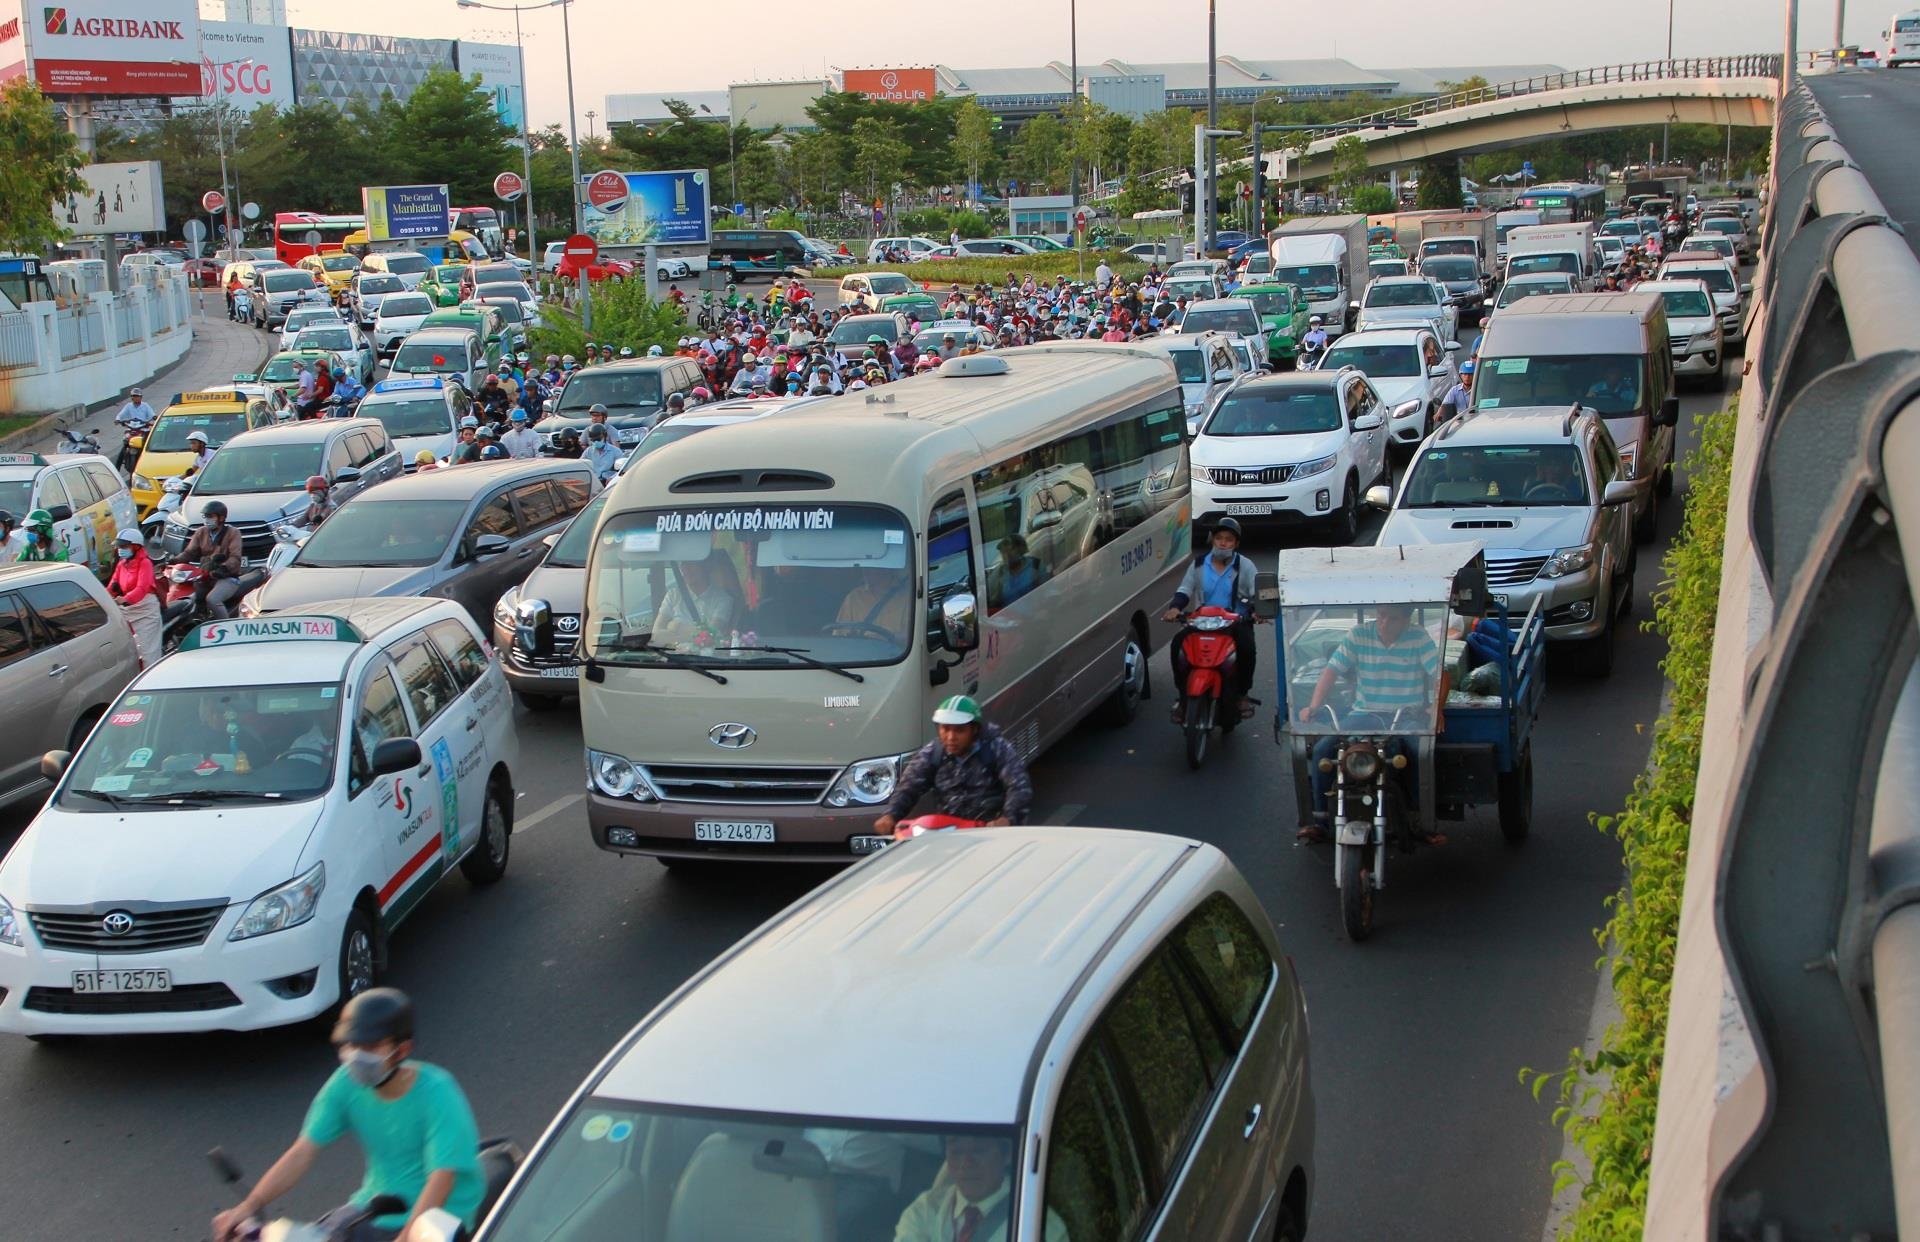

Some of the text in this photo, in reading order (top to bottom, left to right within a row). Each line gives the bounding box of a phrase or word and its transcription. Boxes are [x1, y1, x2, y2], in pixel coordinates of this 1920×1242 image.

[72, 17, 184, 40] AGRIBANK
[226, 34, 234, 42] to
[236, 33, 264, 44] Vietnam
[222, 63, 271, 94] SCG
[863, 90, 926, 100] anwha Life
[400, 193, 433, 202] The Grand
[392, 203, 442, 214] Manhattan
[186, 393, 231, 401] Vinataxi
[17, 455, 32, 463] TAXI
[685, 510, 713, 531] ĐÓN
[714, 509, 742, 530] CÁN
[763, 508, 800, 530] NHÂN
[803, 507, 834, 529] VIÊN
[235, 621, 333, 636] VINASUN TAXI
[823, 695, 861, 708] LIMOUSINE
[397, 814, 423, 846] VINASUN
